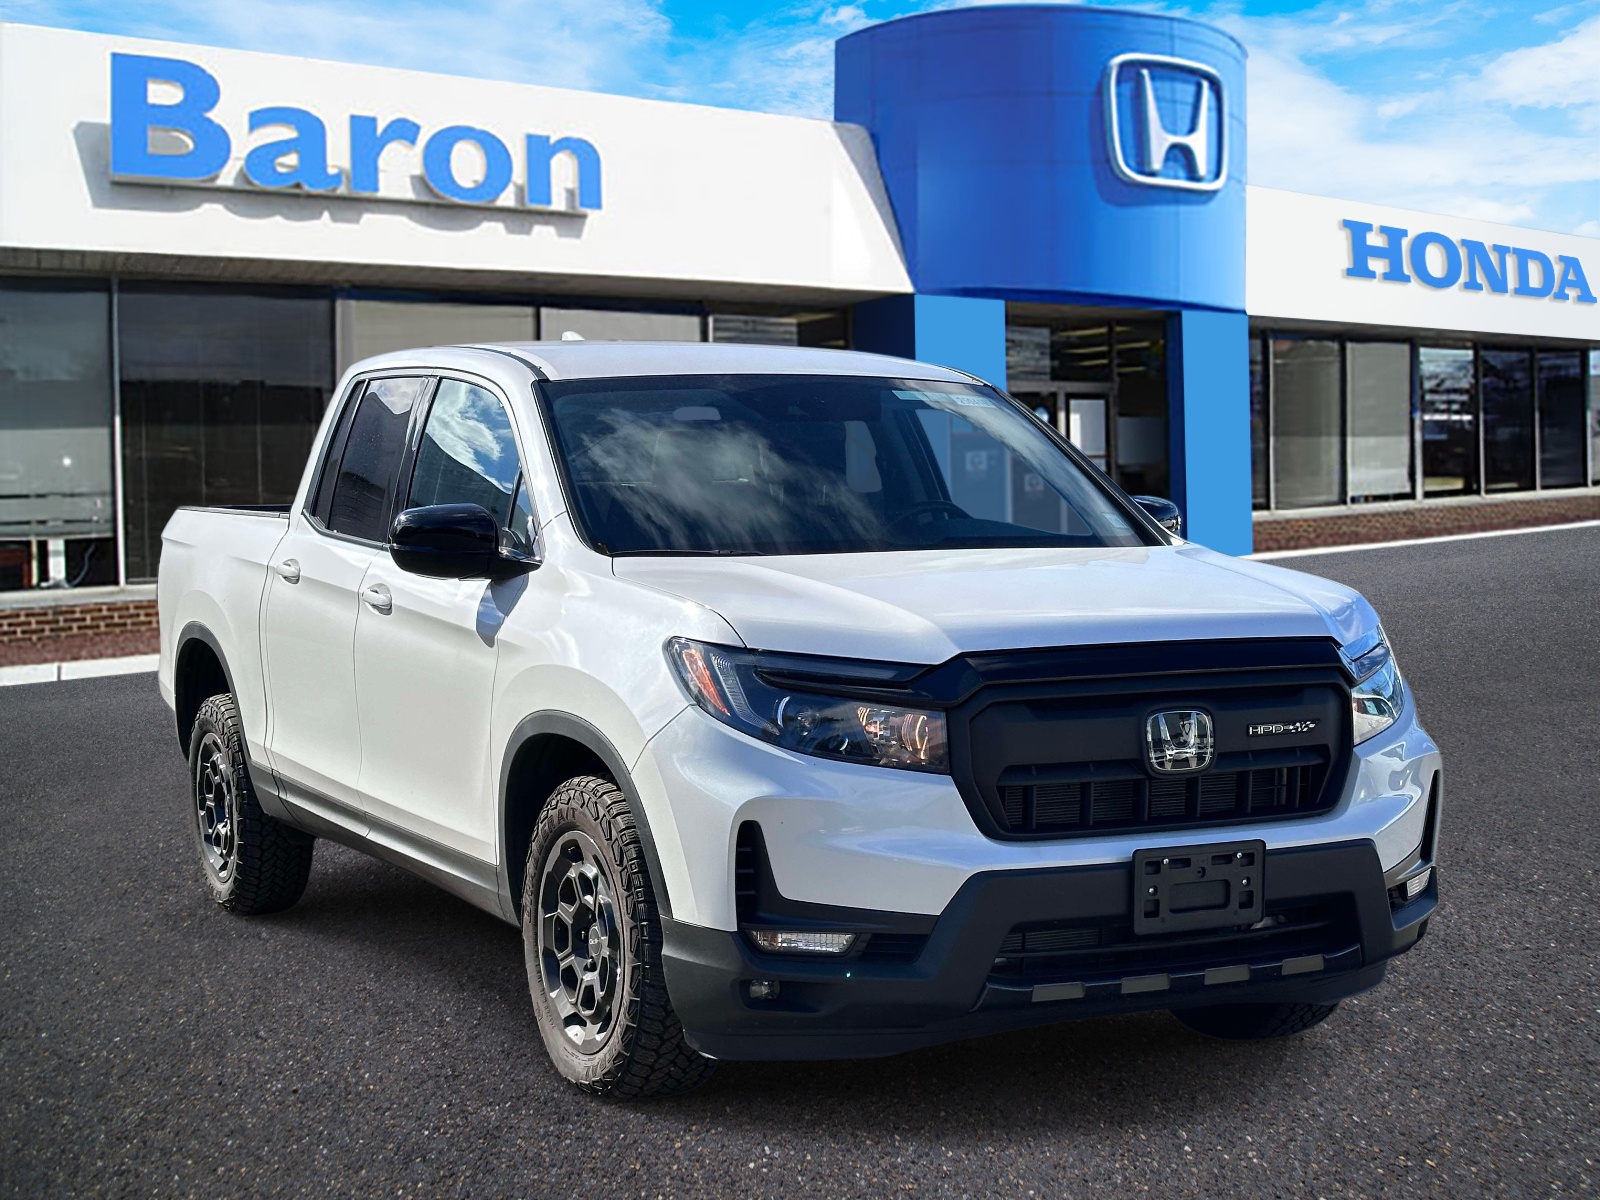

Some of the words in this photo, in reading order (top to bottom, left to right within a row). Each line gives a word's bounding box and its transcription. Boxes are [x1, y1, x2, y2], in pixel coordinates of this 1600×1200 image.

[110, 52, 602, 210] Baron
[1343, 219, 1597, 304] HONDA
[1249, 724, 1284, 735] HPD
